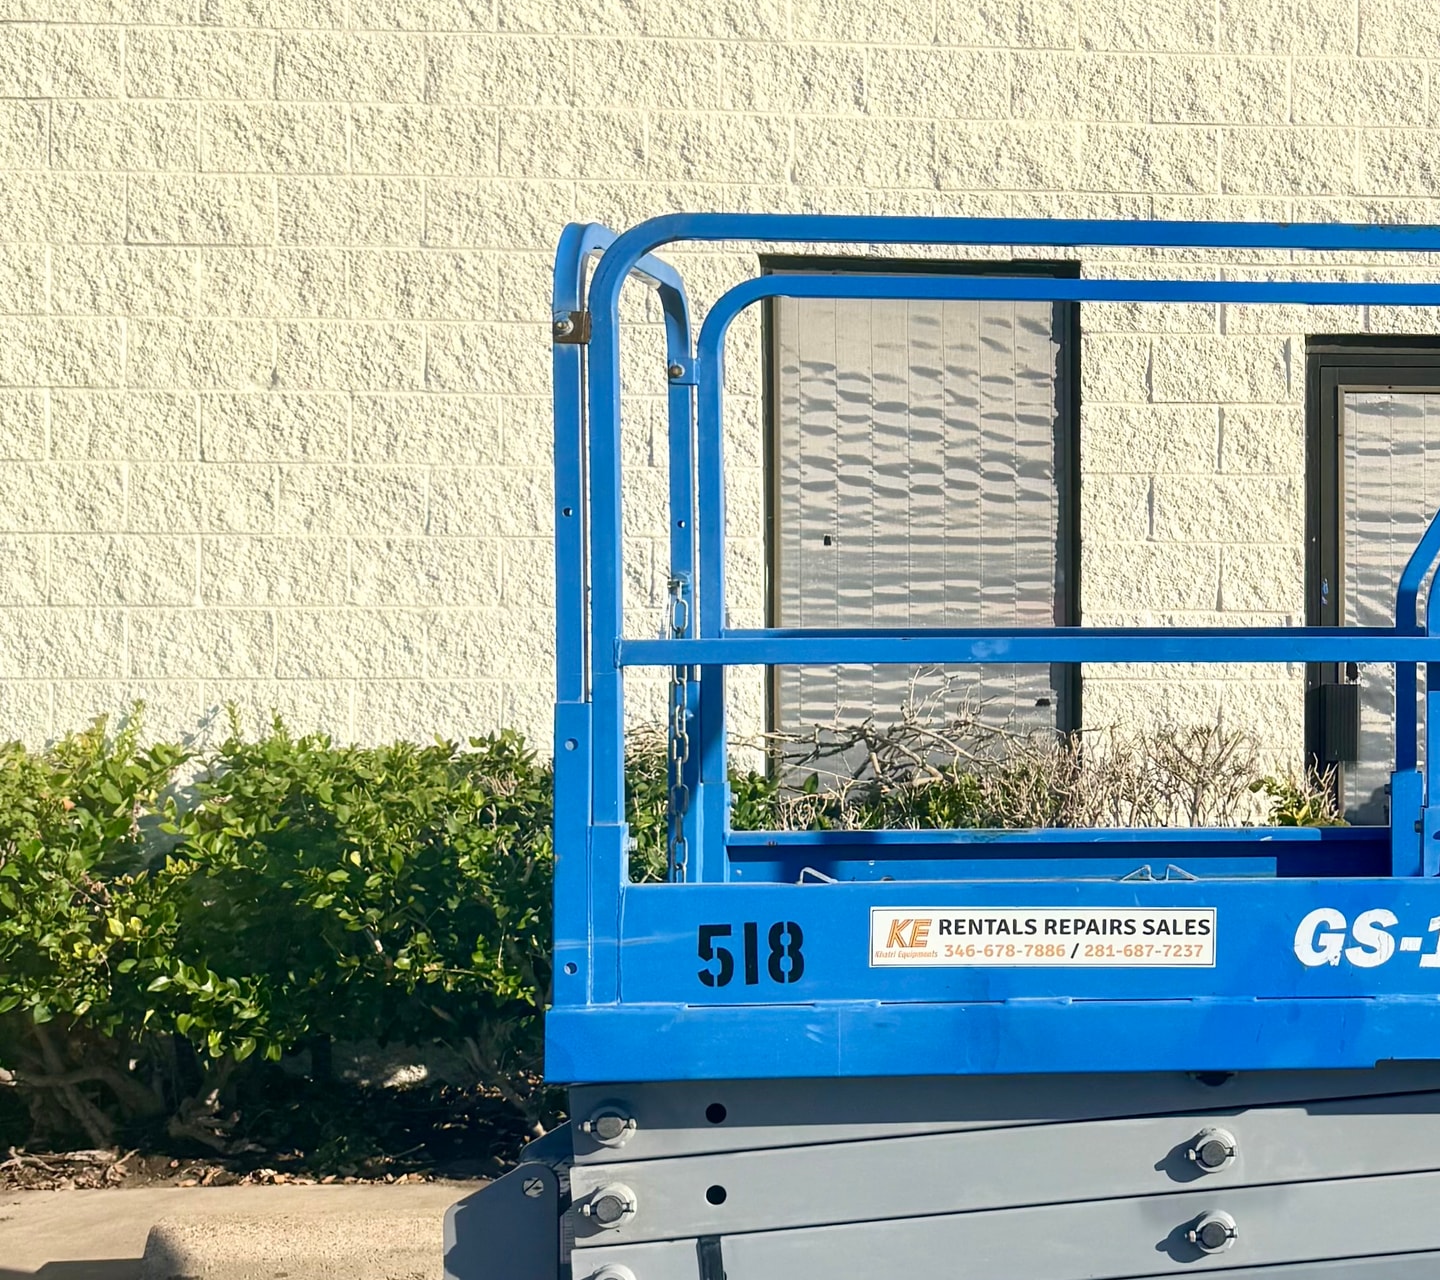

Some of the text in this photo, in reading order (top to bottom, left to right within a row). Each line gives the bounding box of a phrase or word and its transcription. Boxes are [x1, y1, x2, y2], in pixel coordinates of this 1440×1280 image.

[886, 918, 932, 949] KE
[938, 918, 1211, 936] RENTALS REPAIRS SALES
[697, 920, 805, 988] 518
[944, 943, 1066, 958] 346-678-7886
[1084, 943, 1204, 958] 281-687-7237
